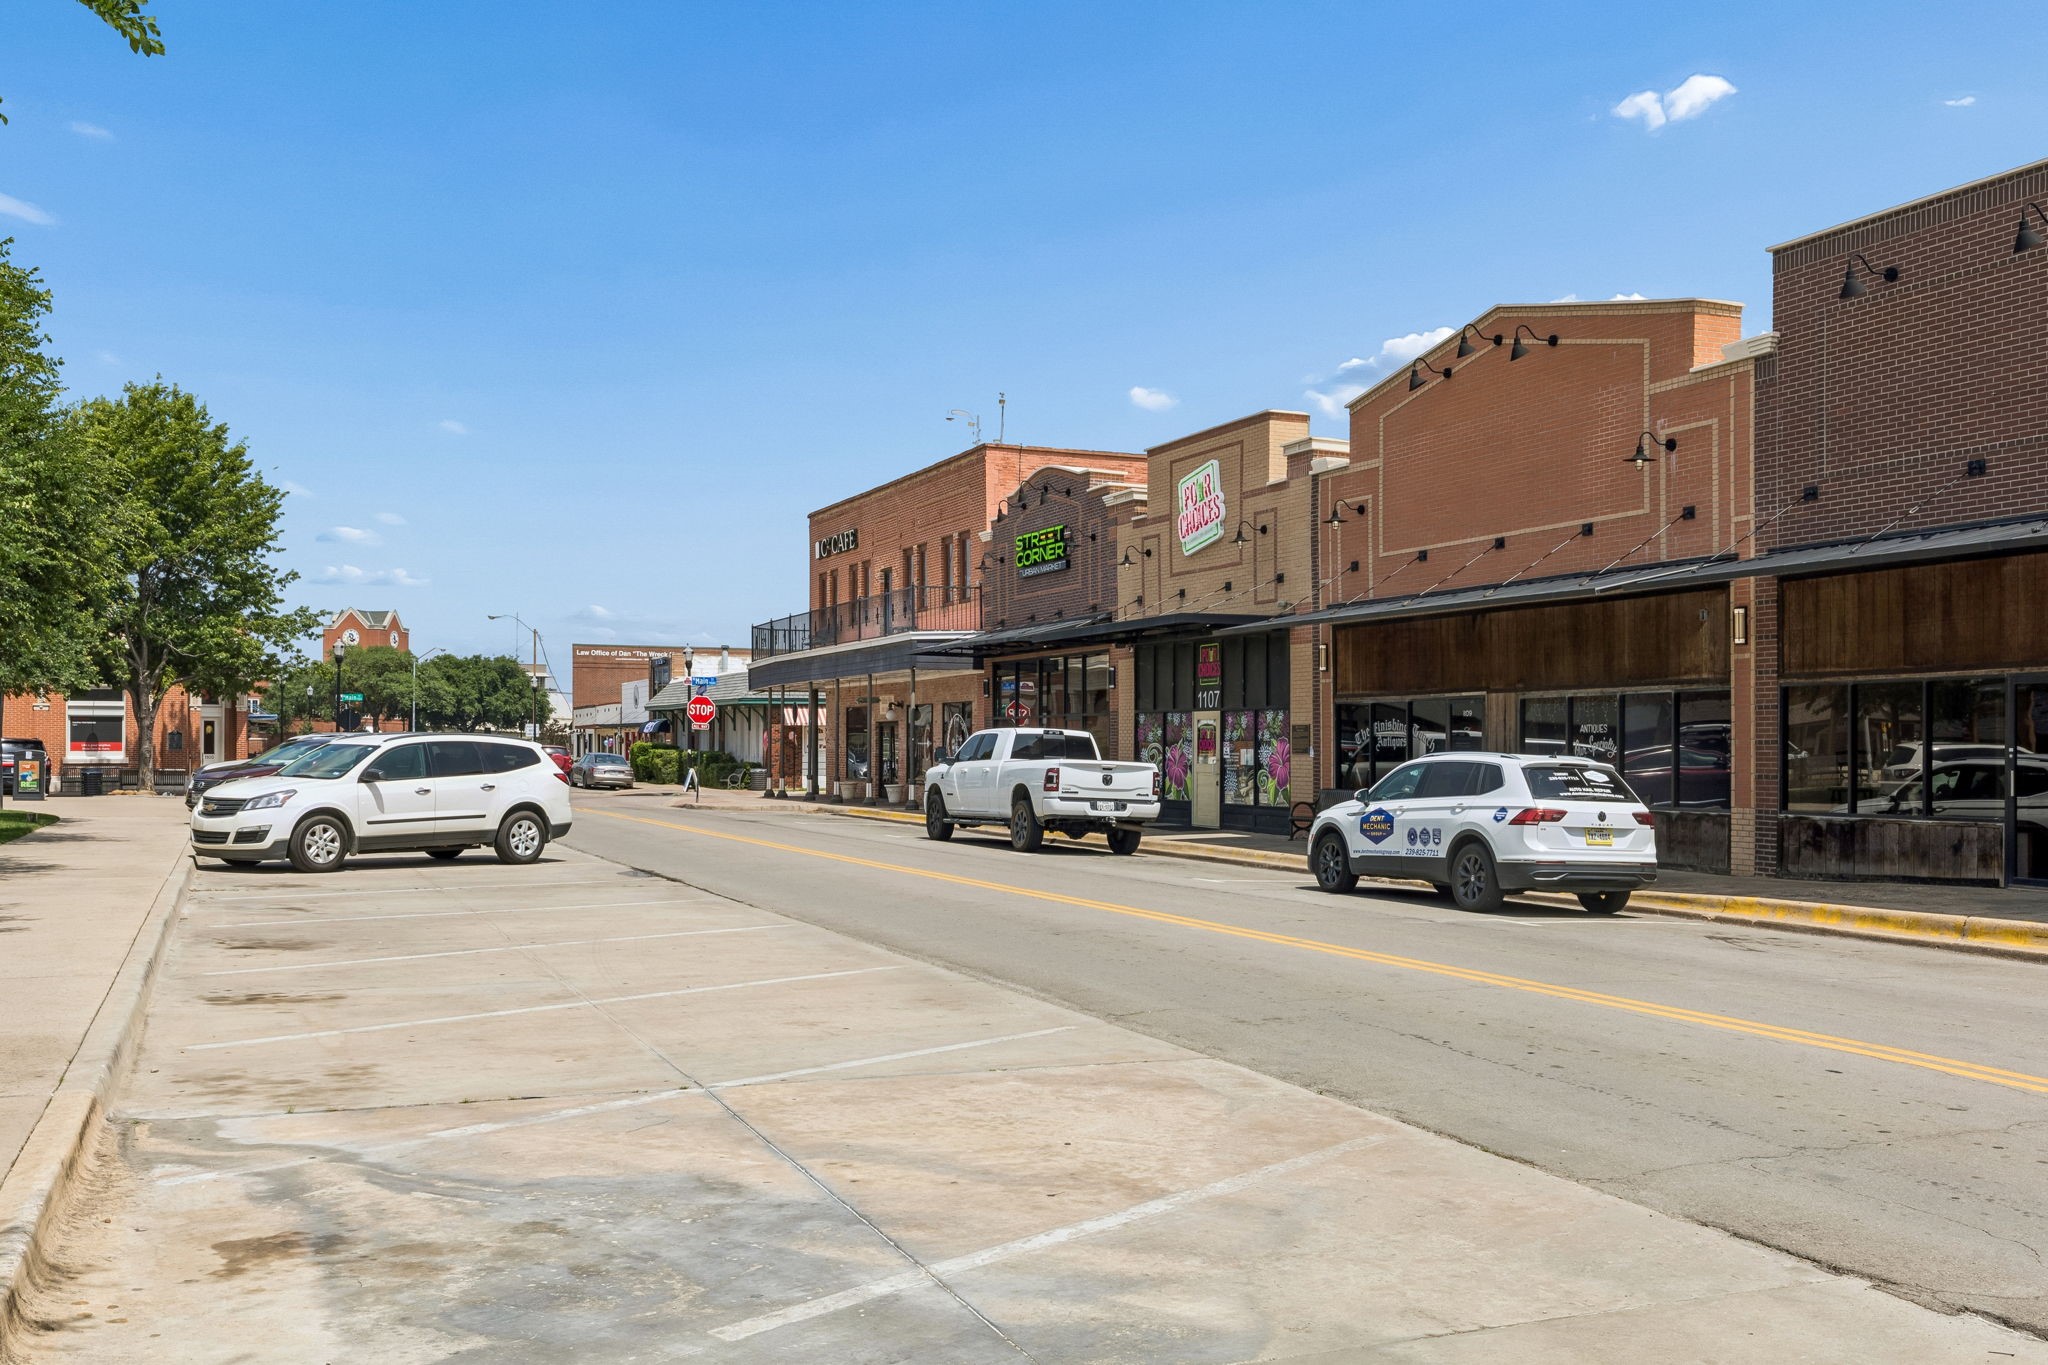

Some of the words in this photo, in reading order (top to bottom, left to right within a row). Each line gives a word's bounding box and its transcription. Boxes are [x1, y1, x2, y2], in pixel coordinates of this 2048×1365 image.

[1180, 494, 1220, 538] CHOICES
[831, 530, 855, 554] CAFE
[1016, 525, 1064, 550] STREET
[1016, 542, 1064, 568] CORNER
[1020, 566, 1040, 576] URBAN
[1040, 560, 1066, 573] MARKET
[1198, 690, 1220, 708] 1107
[690, 704, 714, 716] STOP
[1580, 724, 1608, 733] ANTIQUES
[1354, 728, 1370, 744] The
[1412, 724, 1435, 752] Touch
[1376, 735, 1407, 751] Antiques
[1405, 848, 1439, 856] 239-825-7711
